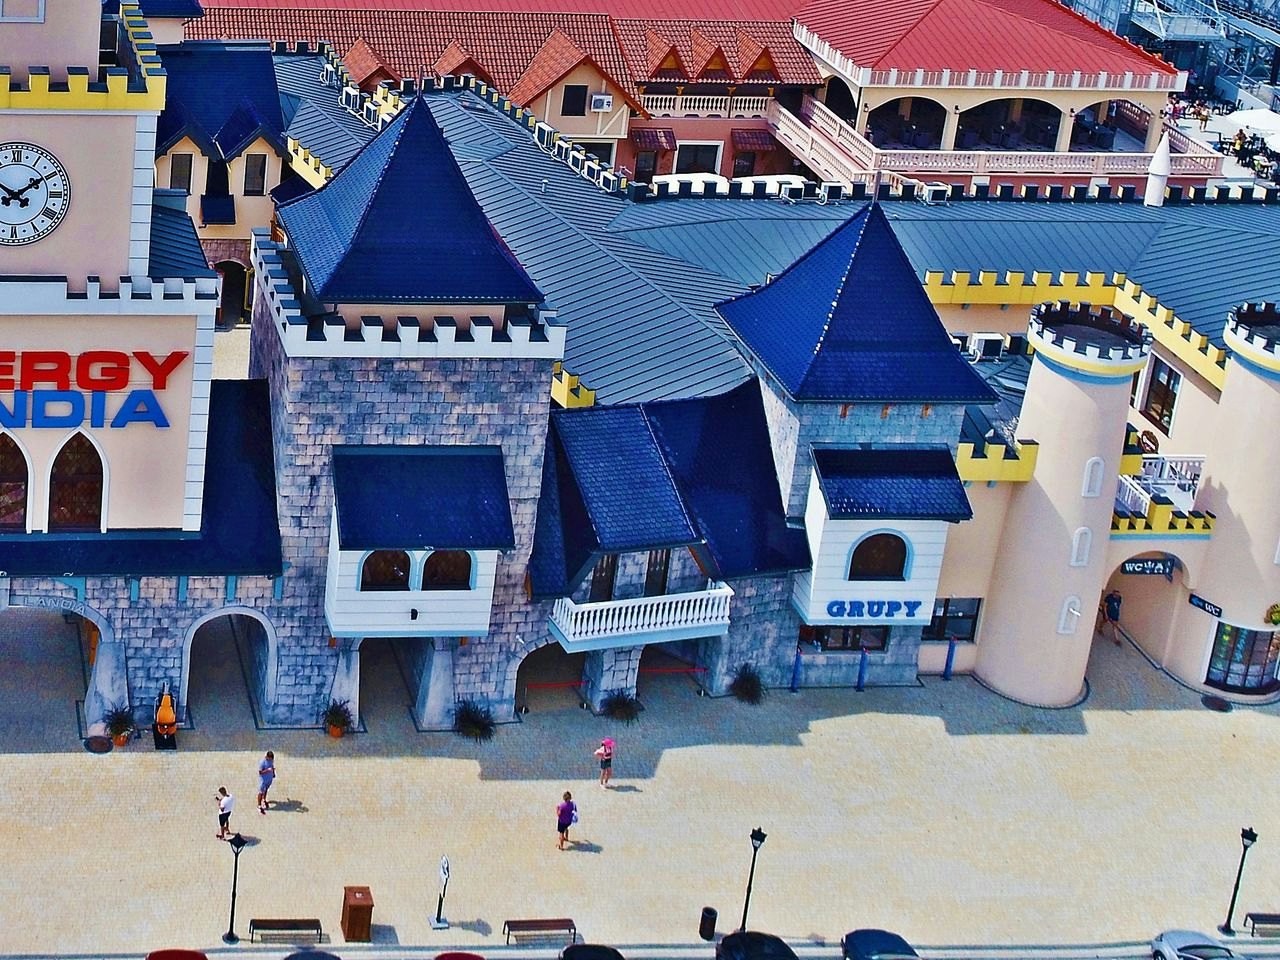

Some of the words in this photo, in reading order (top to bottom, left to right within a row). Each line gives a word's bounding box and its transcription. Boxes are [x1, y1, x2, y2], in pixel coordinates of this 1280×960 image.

[1124, 562, 1144, 573] WC
[23, 597, 87, 615] LANDIA
[826, 600, 922, 618] GRUPY
[1204, 602, 1221, 617] WC
